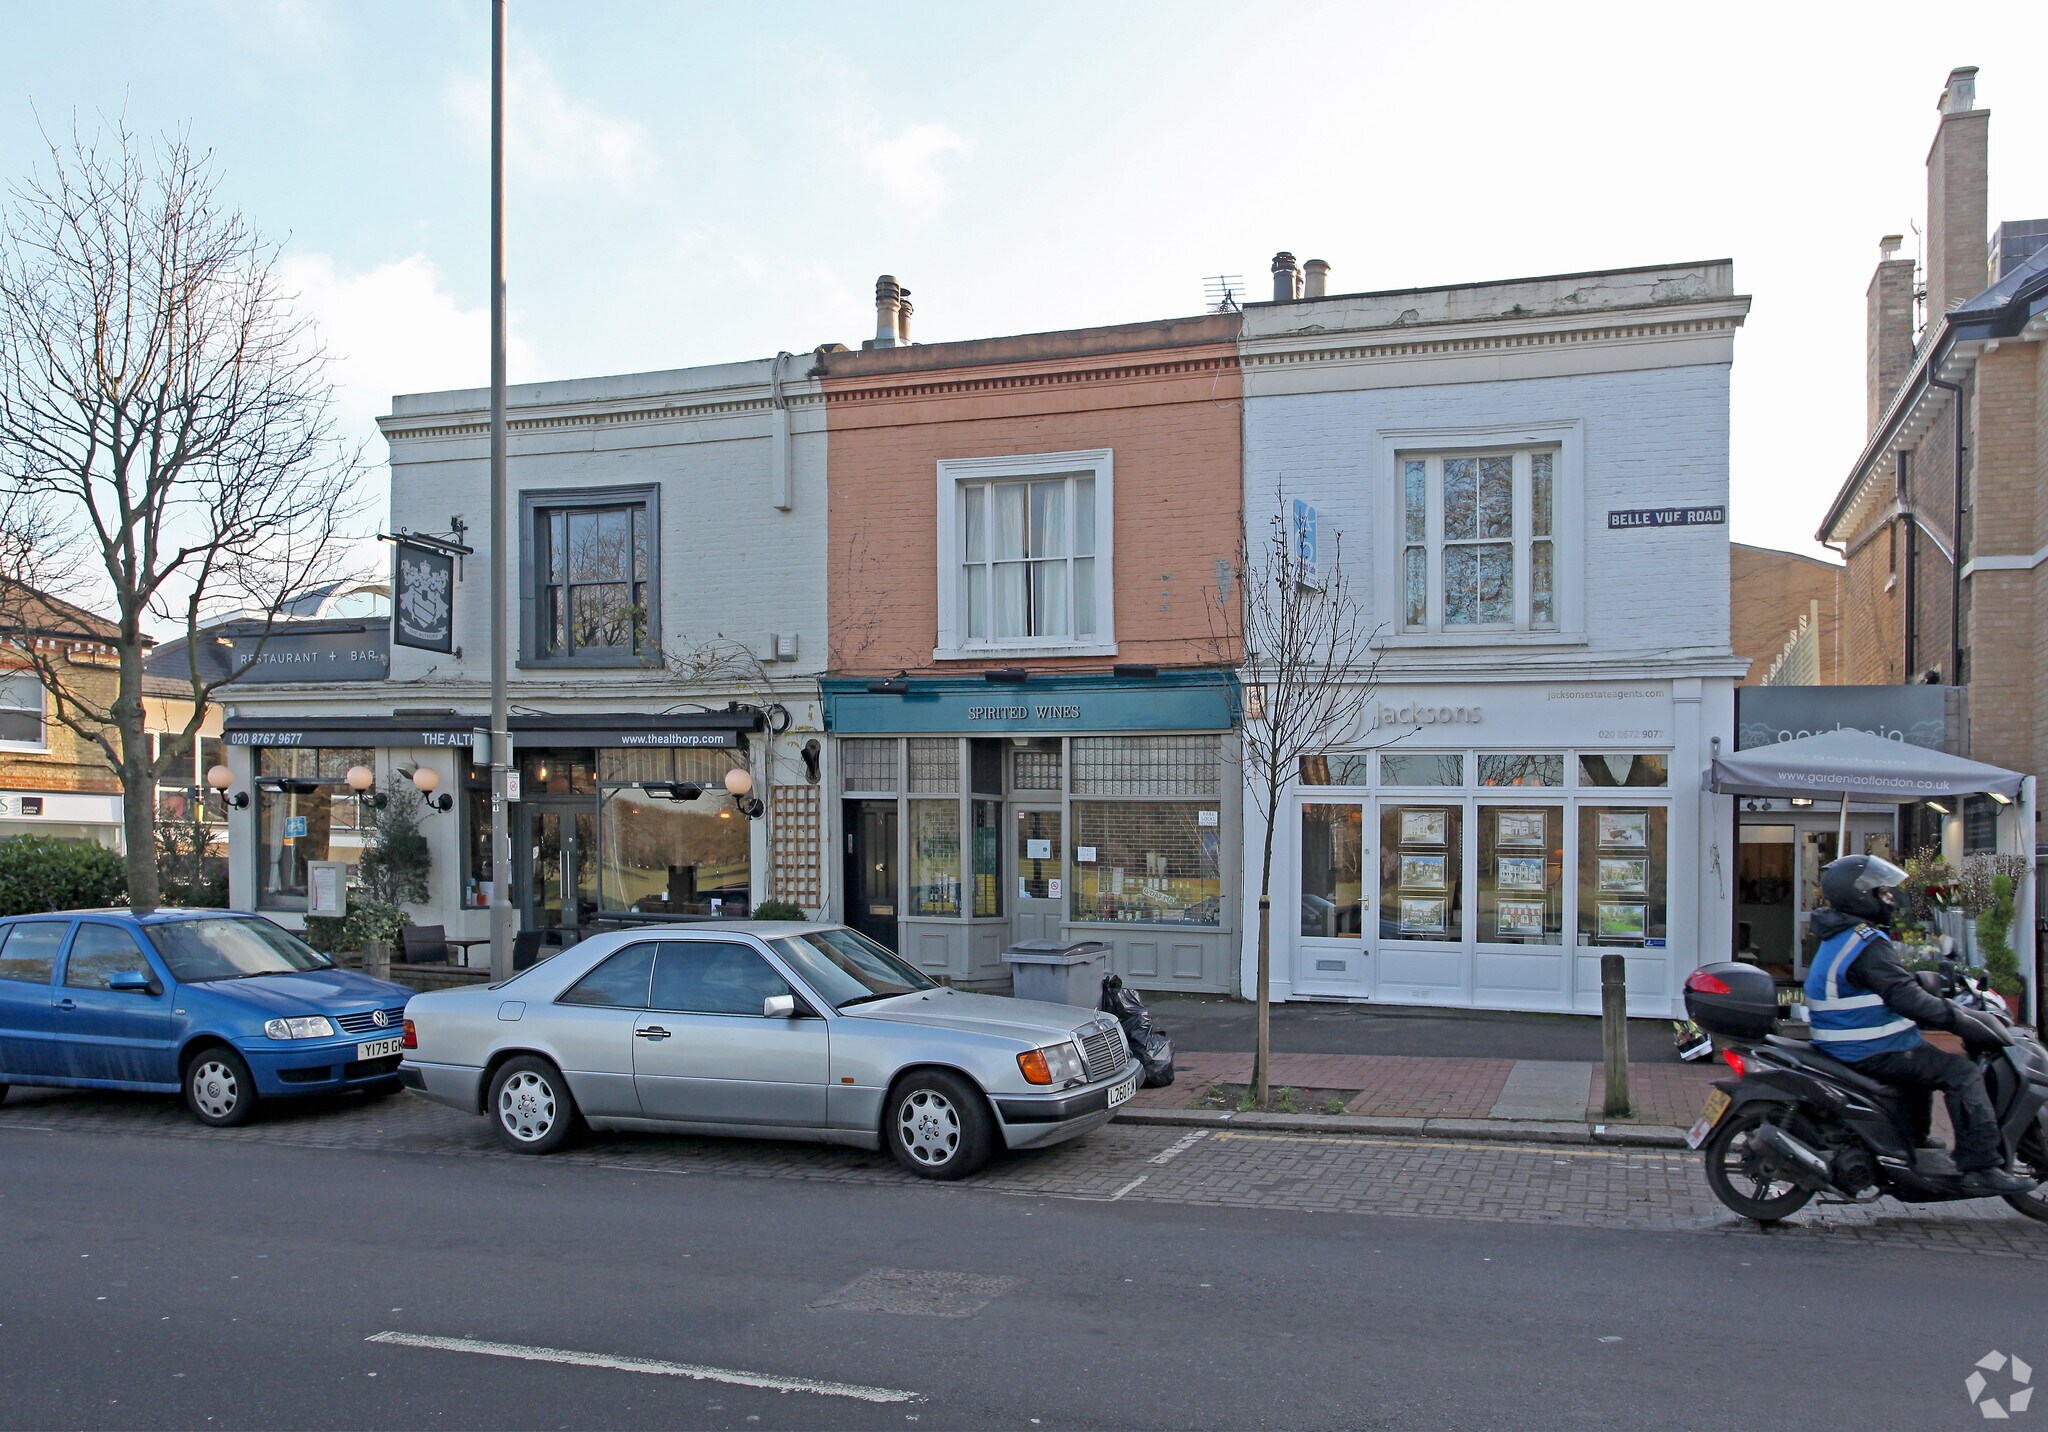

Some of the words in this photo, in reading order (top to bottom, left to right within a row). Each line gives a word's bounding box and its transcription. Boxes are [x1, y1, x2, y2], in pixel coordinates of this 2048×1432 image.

[1611, 513, 1650, 525] BELLE
[1655, 511, 1682, 523] VUE
[1687, 510, 1722, 522] ROAD
[351, 650, 376, 661] BAR
[1547, 690, 1665, 701] jacksonsestateagents.com
[968, 706, 1029, 720] SPIRITED
[1035, 705, 1081, 719] WINES
[1374, 700, 1483, 729] Jacksons
[231, 733, 249, 744] 020
[251, 733, 276, 744] 8767
[278, 733, 303, 744] 9677
[422, 733, 444, 745] THE
[621, 733, 724, 746] www.thealthorp.com
[1598, 730, 1615, 739] 020
[1642, 730, 1664, 739] 9077
[1778, 771, 1950, 790] www.gardeniaoflondon.co.uk
[365, 1042, 389, 1057] Y179
